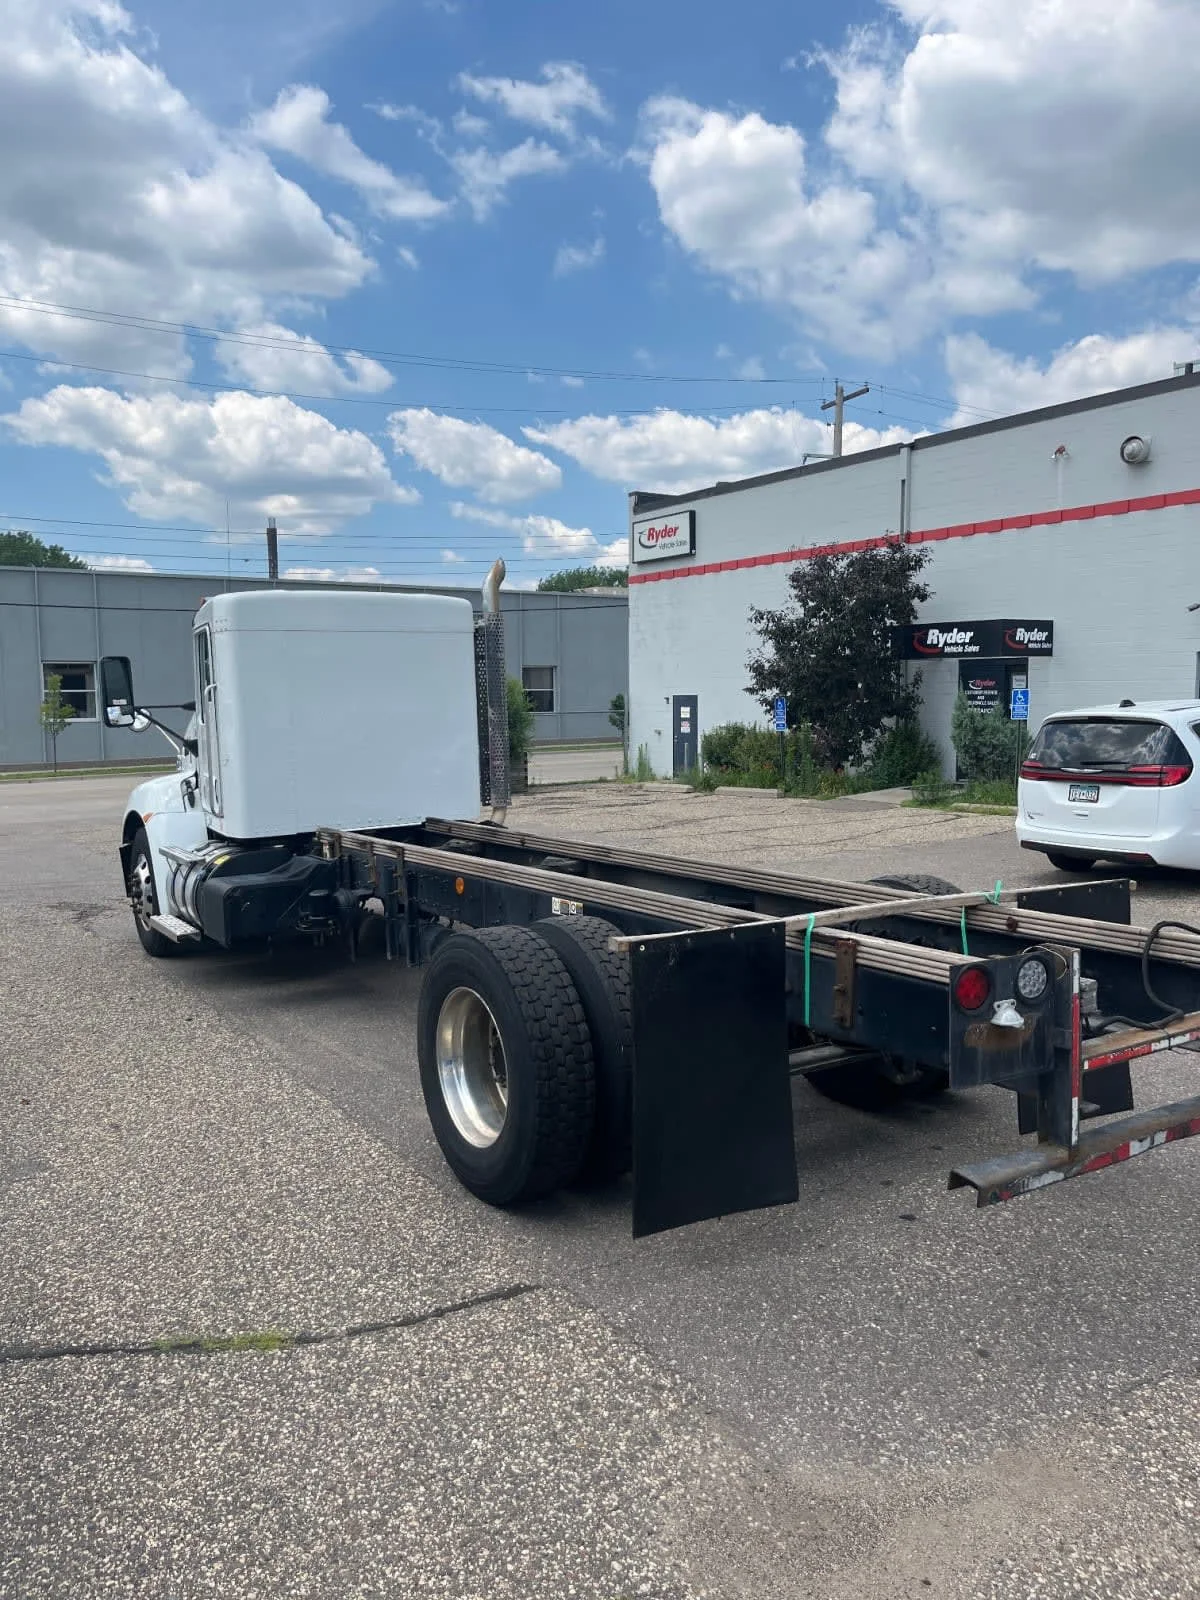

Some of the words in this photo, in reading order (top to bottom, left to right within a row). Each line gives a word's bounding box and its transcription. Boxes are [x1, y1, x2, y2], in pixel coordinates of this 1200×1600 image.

[647, 524, 679, 543] Ryder
[927, 628, 974, 647] Ryder
[1016, 628, 1048, 643] Ryder
[944, 645, 963, 653] Vehicle
[964, 644, 980, 652] Sales
[975, 679, 996, 688] Ryder
